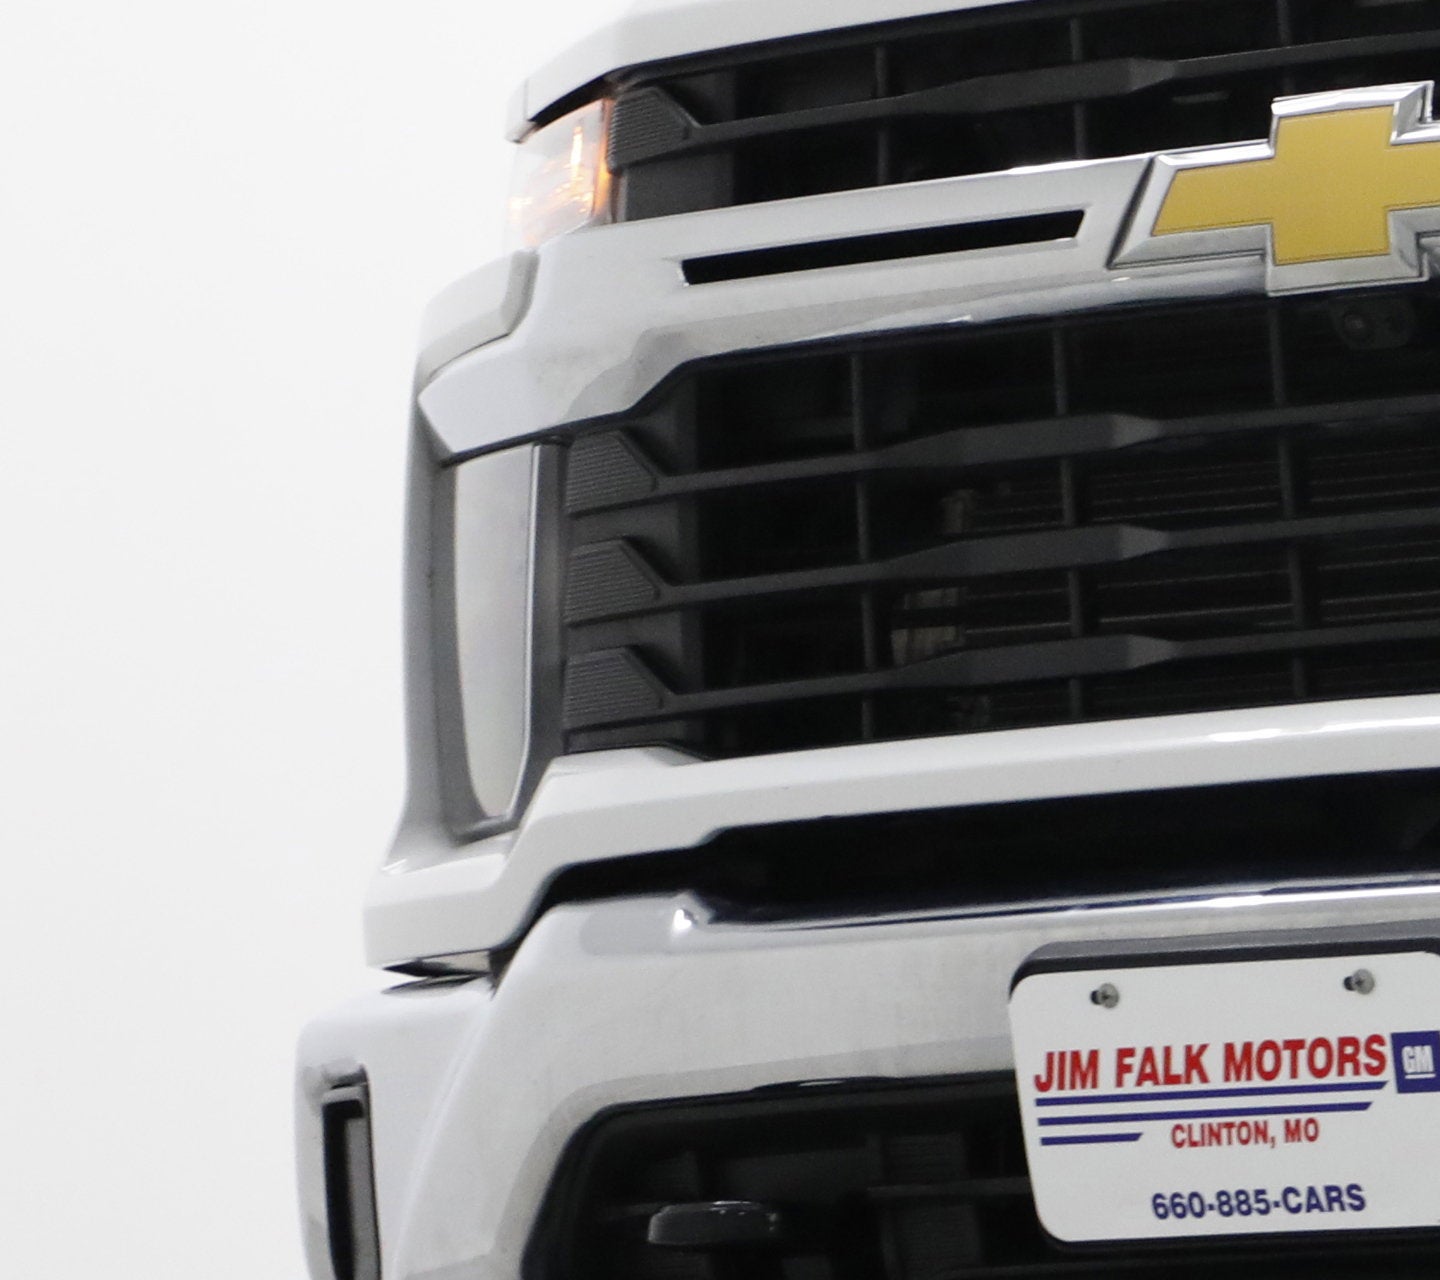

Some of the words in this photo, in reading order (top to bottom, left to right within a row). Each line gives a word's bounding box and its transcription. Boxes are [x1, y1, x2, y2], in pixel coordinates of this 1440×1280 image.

[1034, 1050, 1101, 1092] JIM
[1115, 1043, 1210, 1088] FALK
[1223, 1033, 1388, 1083] MOTORS
[1401, 1044, 1435, 1074] GM
[1171, 1120, 1277, 1149] CLINTON,
[1284, 1117, 1320, 1144] MO
[1151, 1183, 1367, 1220] 660-885-CARS
